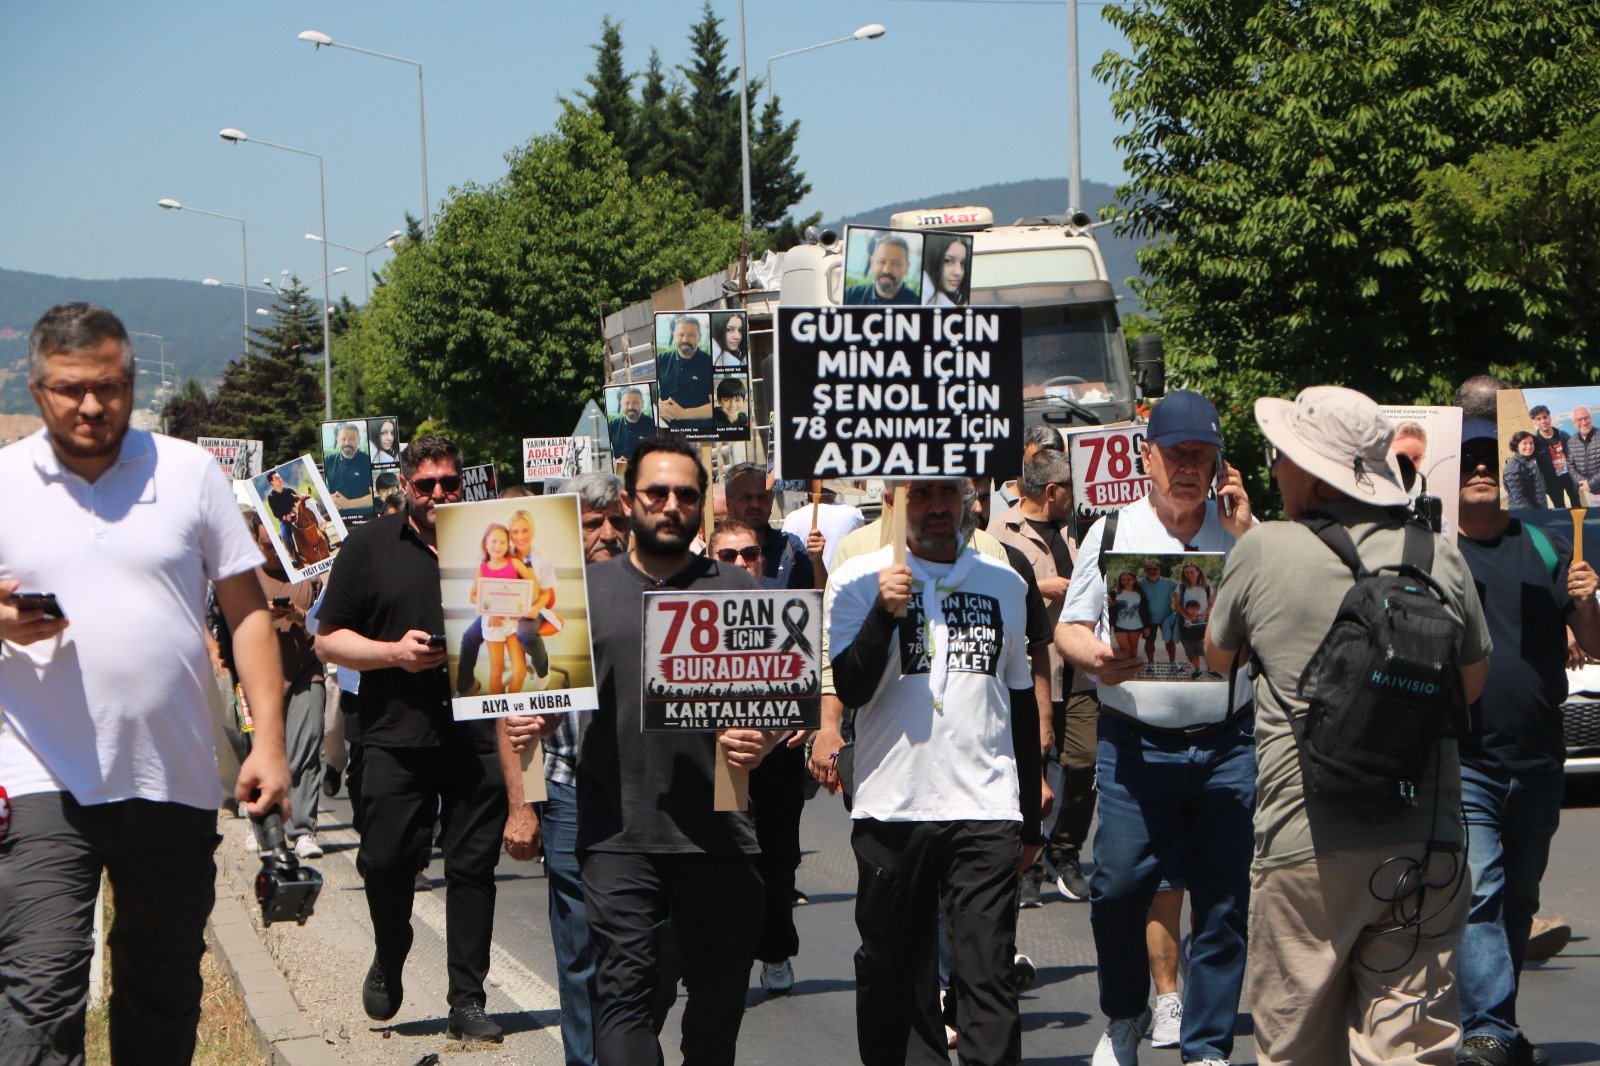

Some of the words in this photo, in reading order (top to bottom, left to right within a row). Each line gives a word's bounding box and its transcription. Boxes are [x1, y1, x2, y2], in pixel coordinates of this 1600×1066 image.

[917, 213, 978, 226] imkar
[791, 307, 921, 347] GÜLÇİN
[933, 308, 999, 347] İÇİN
[818, 345, 911, 379] MİNA
[923, 345, 990, 384] İÇİN
[812, 384, 928, 415] ŞENOL
[938, 380, 1000, 415] İÇİN
[792, 416, 827, 440] 78
[835, 416, 951, 440] CANIMIZ
[961, 413, 1010, 442] İÇİN
[201, 440, 219, 448] YARIM
[221, 440, 240, 448] KALAN
[527, 439, 546, 448] YARIM
[548, 438, 567, 446] KALAN
[528, 447, 565, 459] ADALET
[813, 442, 994, 475] ADALET
[1079, 434, 1132, 483] 78
[530, 458, 560, 467] ADALET
[965, 594, 992, 611] İÇİN
[658, 599, 719, 654] 78
[723, 598, 774, 627] CAN
[962, 610, 991, 626] İÇİN
[733, 630, 765, 650] İÇİN
[969, 625, 996, 642] İÇİN
[908, 643, 923, 654] 78
[980, 642, 997, 654] İÇİN
[672, 655, 793, 681] BURADAYIZ
[917, 653, 990, 671] AALET
[482, 699, 509, 714] ALYA
[513, 702, 524, 711] ve
[529, 694, 571, 711] KÜBRA
[665, 700, 801, 718] KARTALKAYA
[680, 719, 709, 728] AİLE
[717, 718, 789, 727] PLATFORMU
